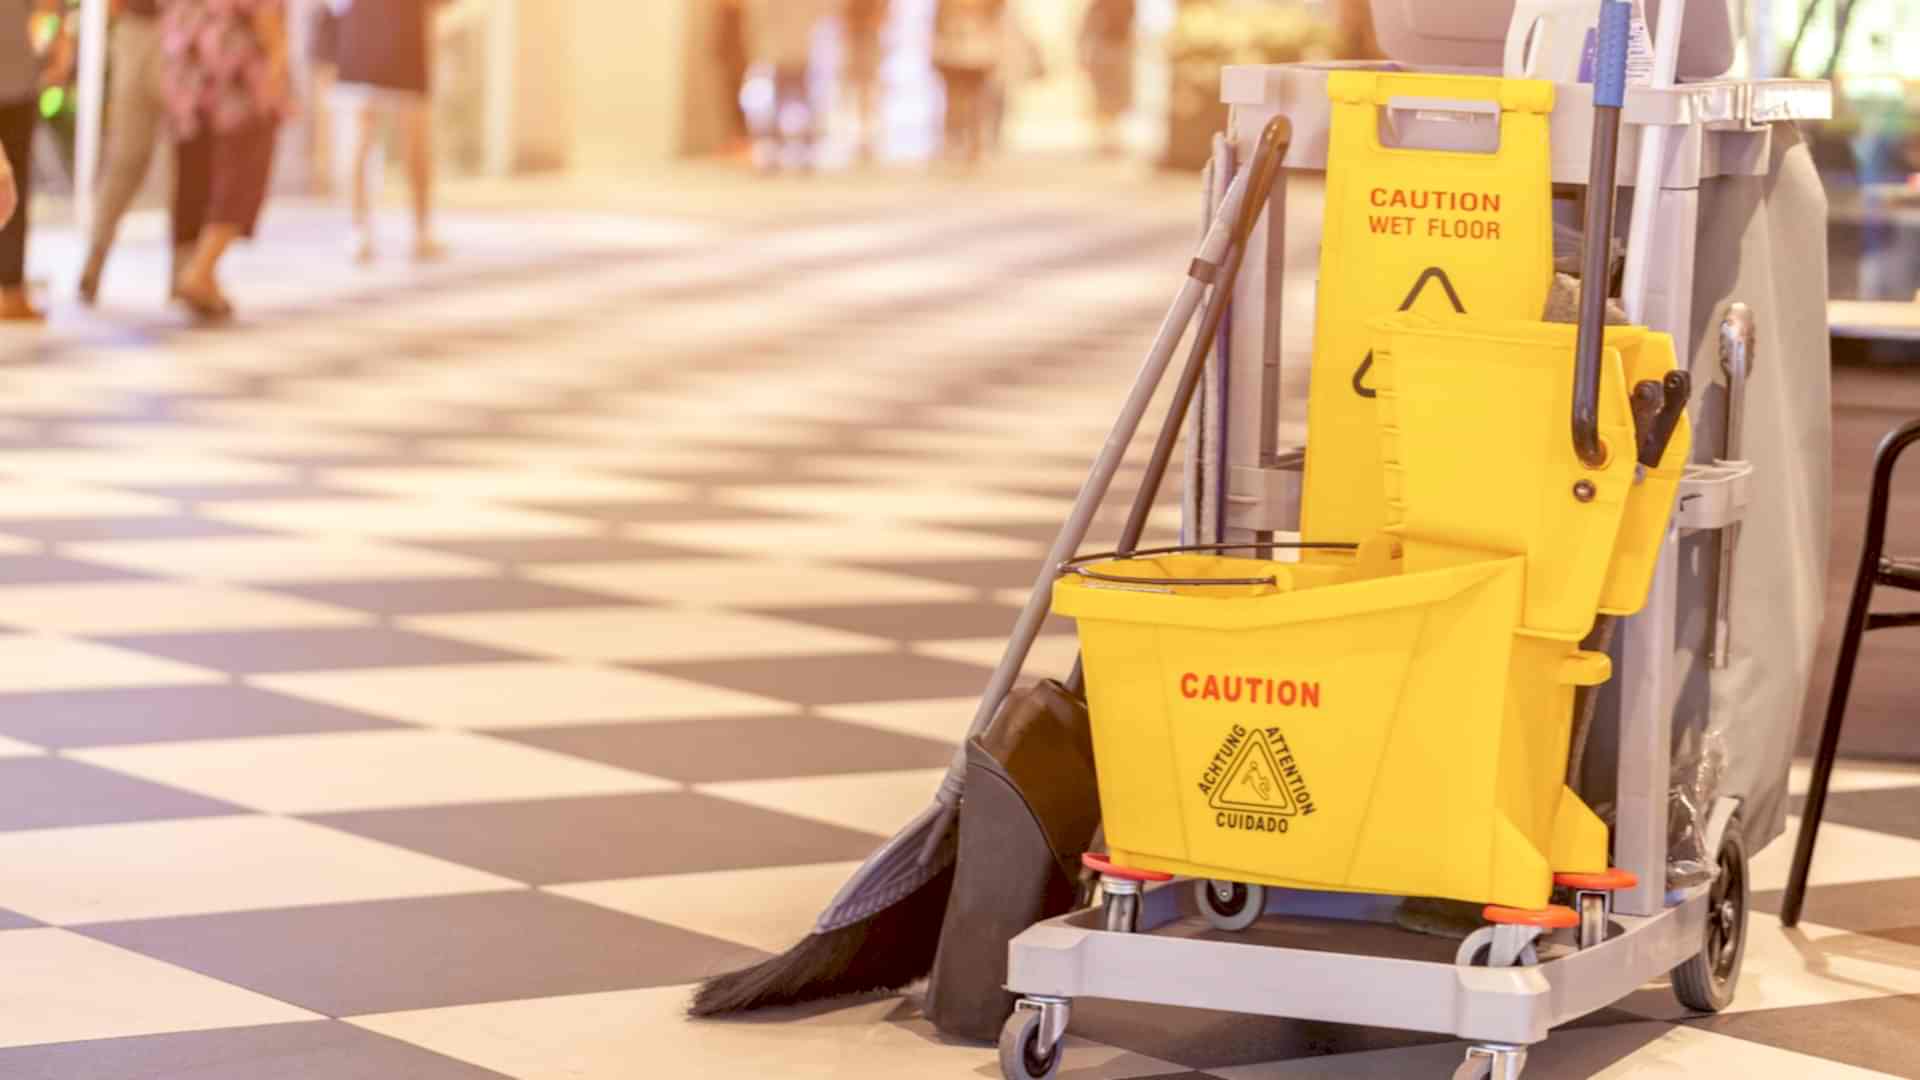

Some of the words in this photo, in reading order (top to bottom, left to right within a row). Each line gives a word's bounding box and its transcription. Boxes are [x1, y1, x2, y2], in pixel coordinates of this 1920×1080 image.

[1370, 188, 1500, 212] CAUTION
[1369, 215, 1416, 235] WET
[1428, 218, 1500, 240] FLOOR
[1181, 672, 1320, 708] CAUTION
[1198, 724, 1247, 795] ACHTUNG
[1265, 726, 1316, 816] ATTENTION
[1216, 812, 1289, 834] CUIDADO
